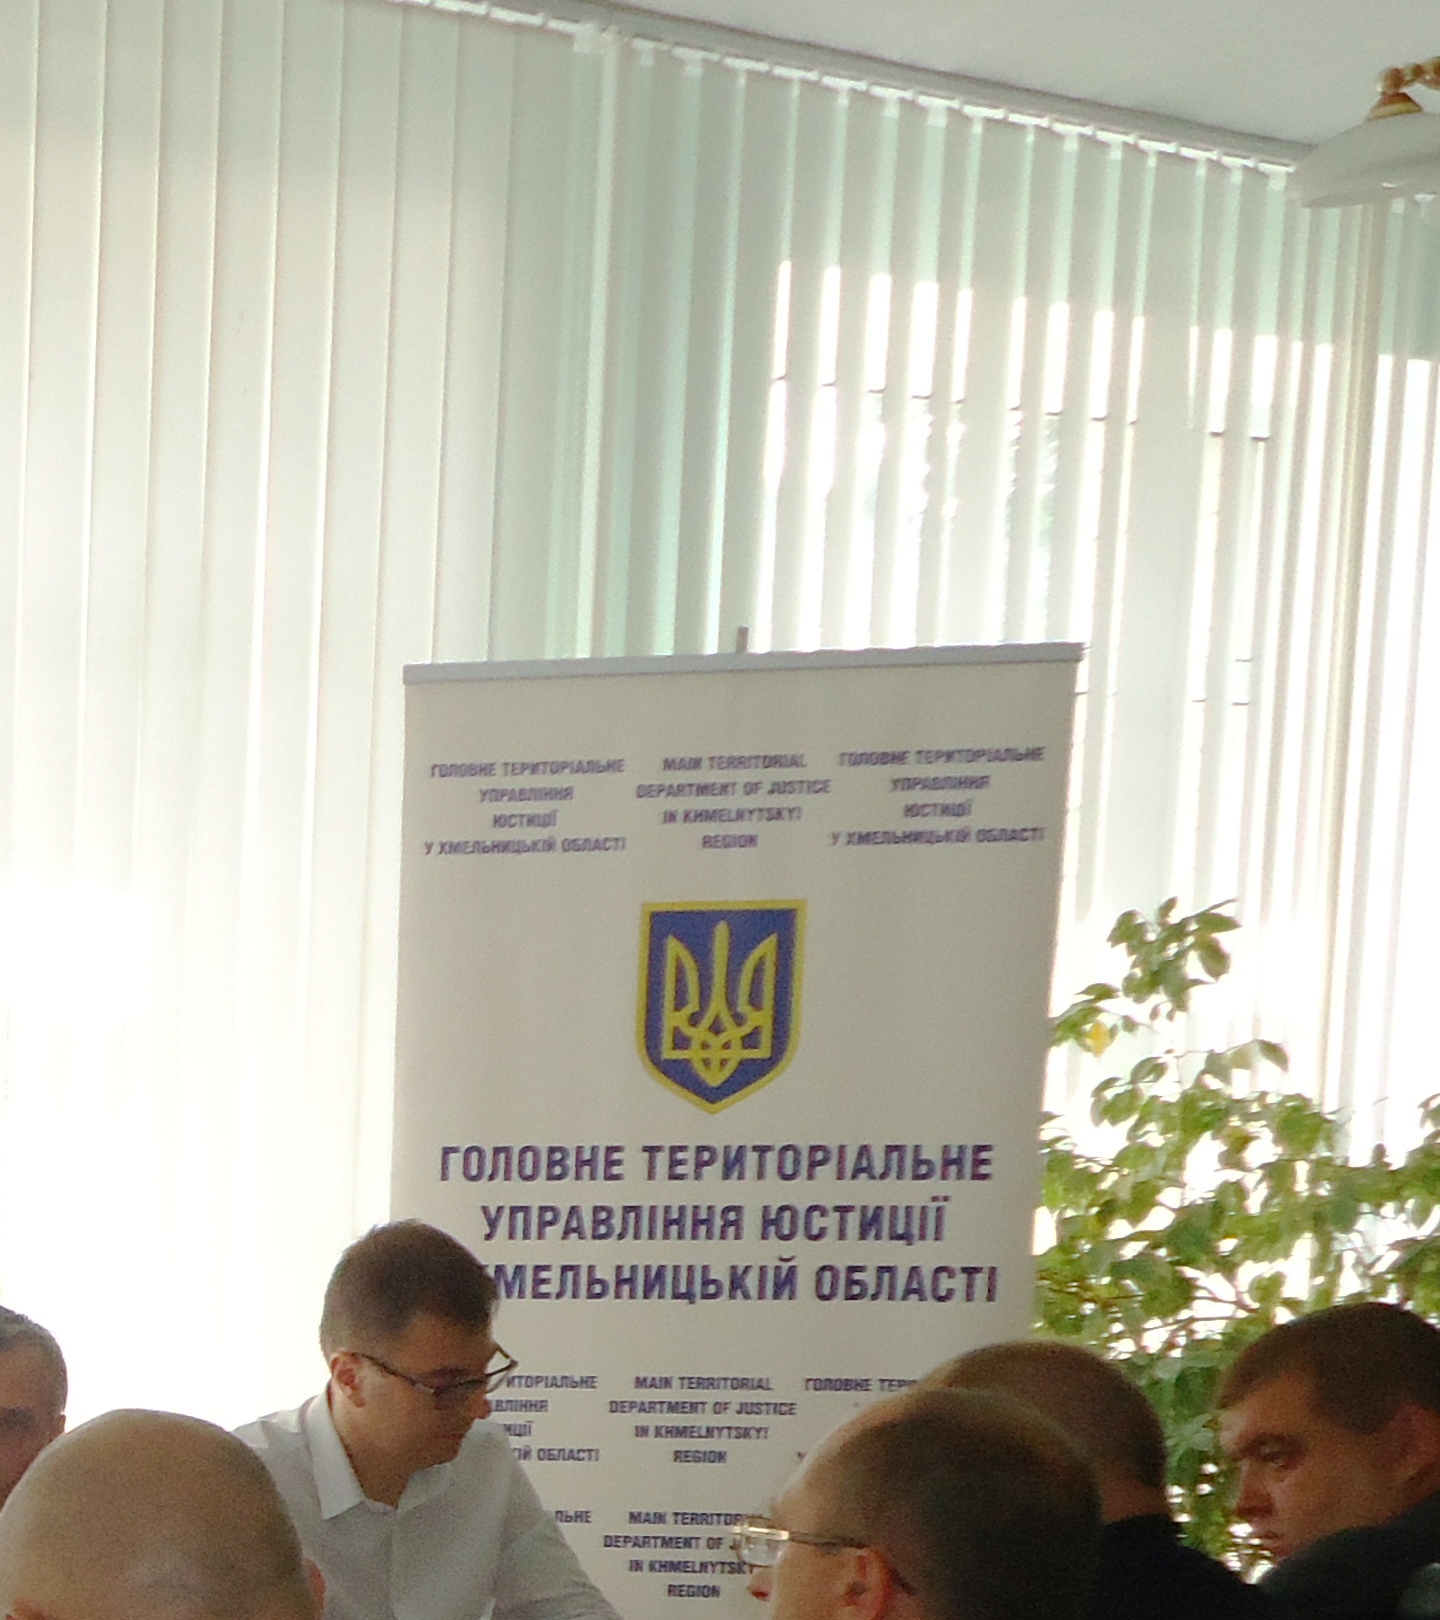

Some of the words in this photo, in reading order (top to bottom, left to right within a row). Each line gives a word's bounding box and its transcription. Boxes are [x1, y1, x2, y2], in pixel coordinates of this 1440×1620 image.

[662, 756, 702, 771] MAIN
[709, 754, 807, 769] TERRITORIAL
[839, 751, 909, 766] ГОЛОВНЕ
[431, 763, 496, 778] ГОЛОВНЕ
[503, 758, 625, 776] ТЕРИТОРІАЛЬНЕ
[636, 782, 737, 798] DEPARTMENT
[744, 780, 763, 795] OF
[767, 779, 831, 795] JUSTICE
[663, 809, 677, 824] IN
[424, 841, 434, 855] У
[562, 837, 626, 852] ОБЛАСТІ
[702, 834, 758, 848] REGION
[440, 1145, 626, 1182] ГОЛОВНЕ
[642, 1144, 994, 1182] ТЕРИТОРІАЛЬНЕ
[481, 1204, 744, 1242] УПРАВЛІННЯ
[760, 1196, 951, 1246] ЮСТИЦІЇ
[486, 1255, 797, 1304] МЕЛЬНИЦЬКІЙ
[814, 1264, 997, 1303] ОБЛАСТІ
[506, 1376, 598, 1389] ИТОРІАЛЬНЕ
[635, 1376, 672, 1390] MAIN
[679, 1376, 773, 1391] TERRITORIAL
[805, 1378, 872, 1391] ГОЛОВНЕ
[609, 1400, 707, 1414] DEPARTMENT
[713, 1401, 729, 1414] OF
[736, 1401, 797, 1416] JUSTICE
[635, 1425, 649, 1438] IN
[537, 1448, 599, 1461] ОБЛАСТІ
[674, 1450, 726, 1464] REGION
[629, 1511, 666, 1525] MAIN
[604, 1535, 700, 1549] DEPARTMENT
[706, 1536, 723, 1549] OF
[629, 1559, 643, 1572] IN
[649, 1560, 754, 1574] KHMELNYTSKY
[667, 1584, 720, 1598] REGION
